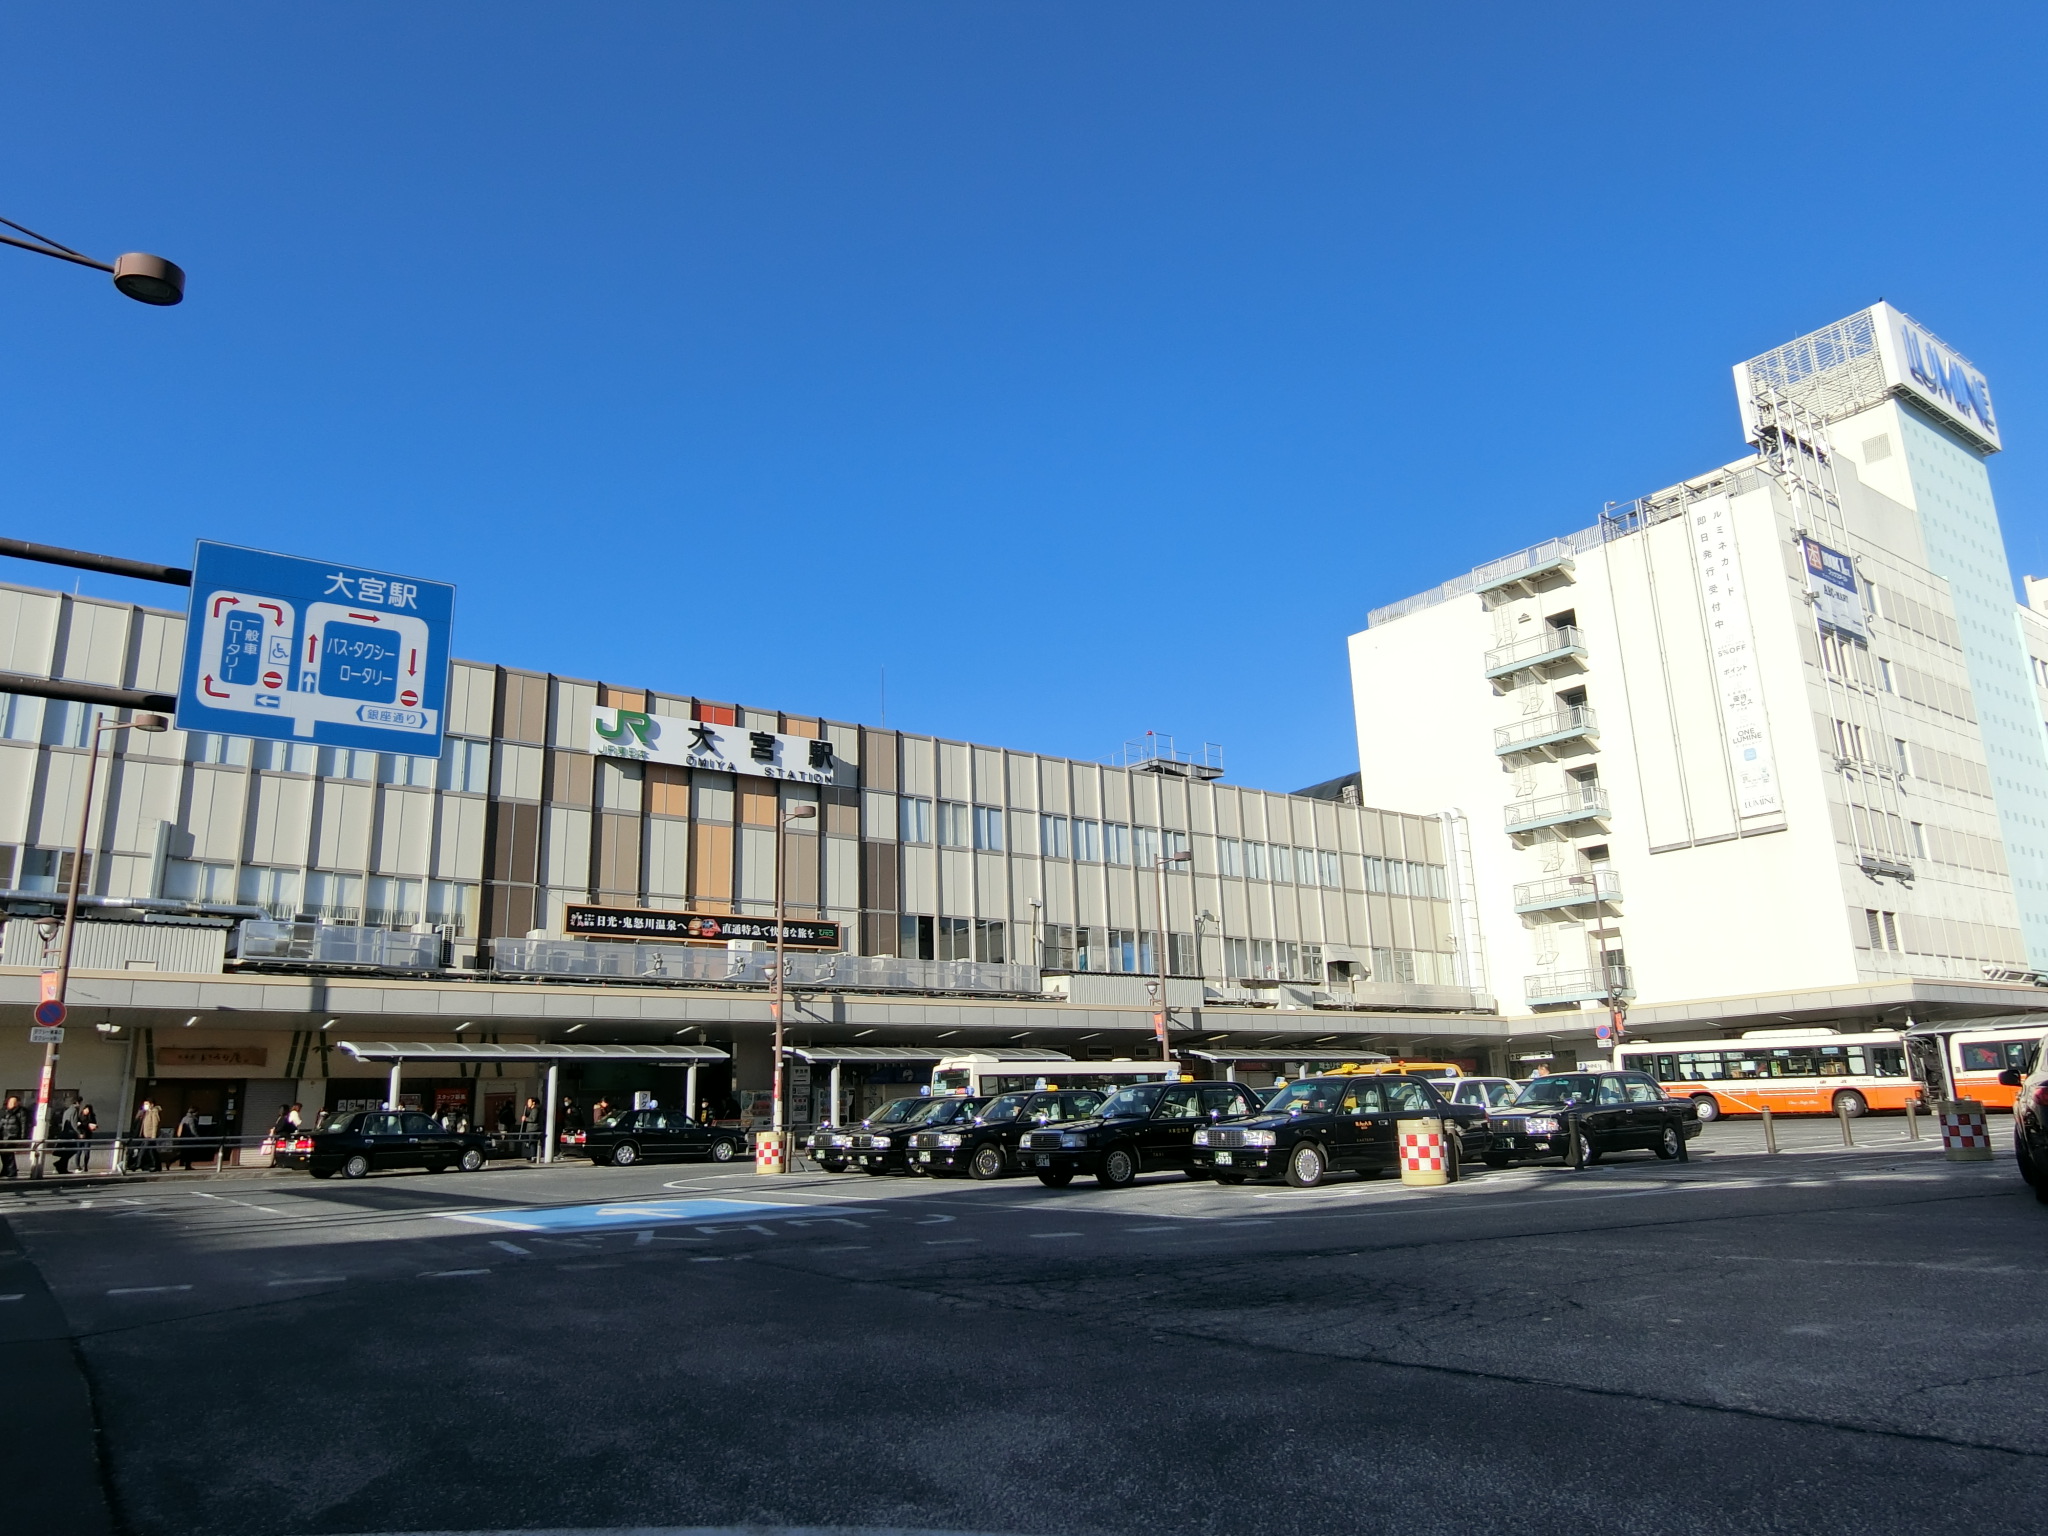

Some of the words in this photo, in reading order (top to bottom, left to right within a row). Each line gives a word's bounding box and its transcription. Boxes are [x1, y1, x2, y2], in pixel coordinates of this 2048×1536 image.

[1902, 325, 1995, 435] LUMINE
[1712, 510, 1735, 597] ルミネカード
[1696, 515, 1724, 631] 即日発行受付中
[323, 572, 418, 610] 大宮駅
[243, 619, 261, 656] 一般車
[326, 637, 396, 661] バス・タクシー
[225, 620, 242, 681] ロータリー
[1717, 643, 1747, 658] 5%OFF
[339, 665, 393, 687] ロータリー
[366, 708, 417, 726] 銀座通り
[595, 709, 652, 745] JR
[1732, 731, 1763, 744] LUMINE
[1737, 727, 1755, 737] ONE
[687, 722, 834, 769] 大宮駅
[764, 767, 834, 784] STATION
[1744, 796, 1776, 809] LUMINE
[596, 915, 688, 931] 日光・鬼怒川温泉へ
